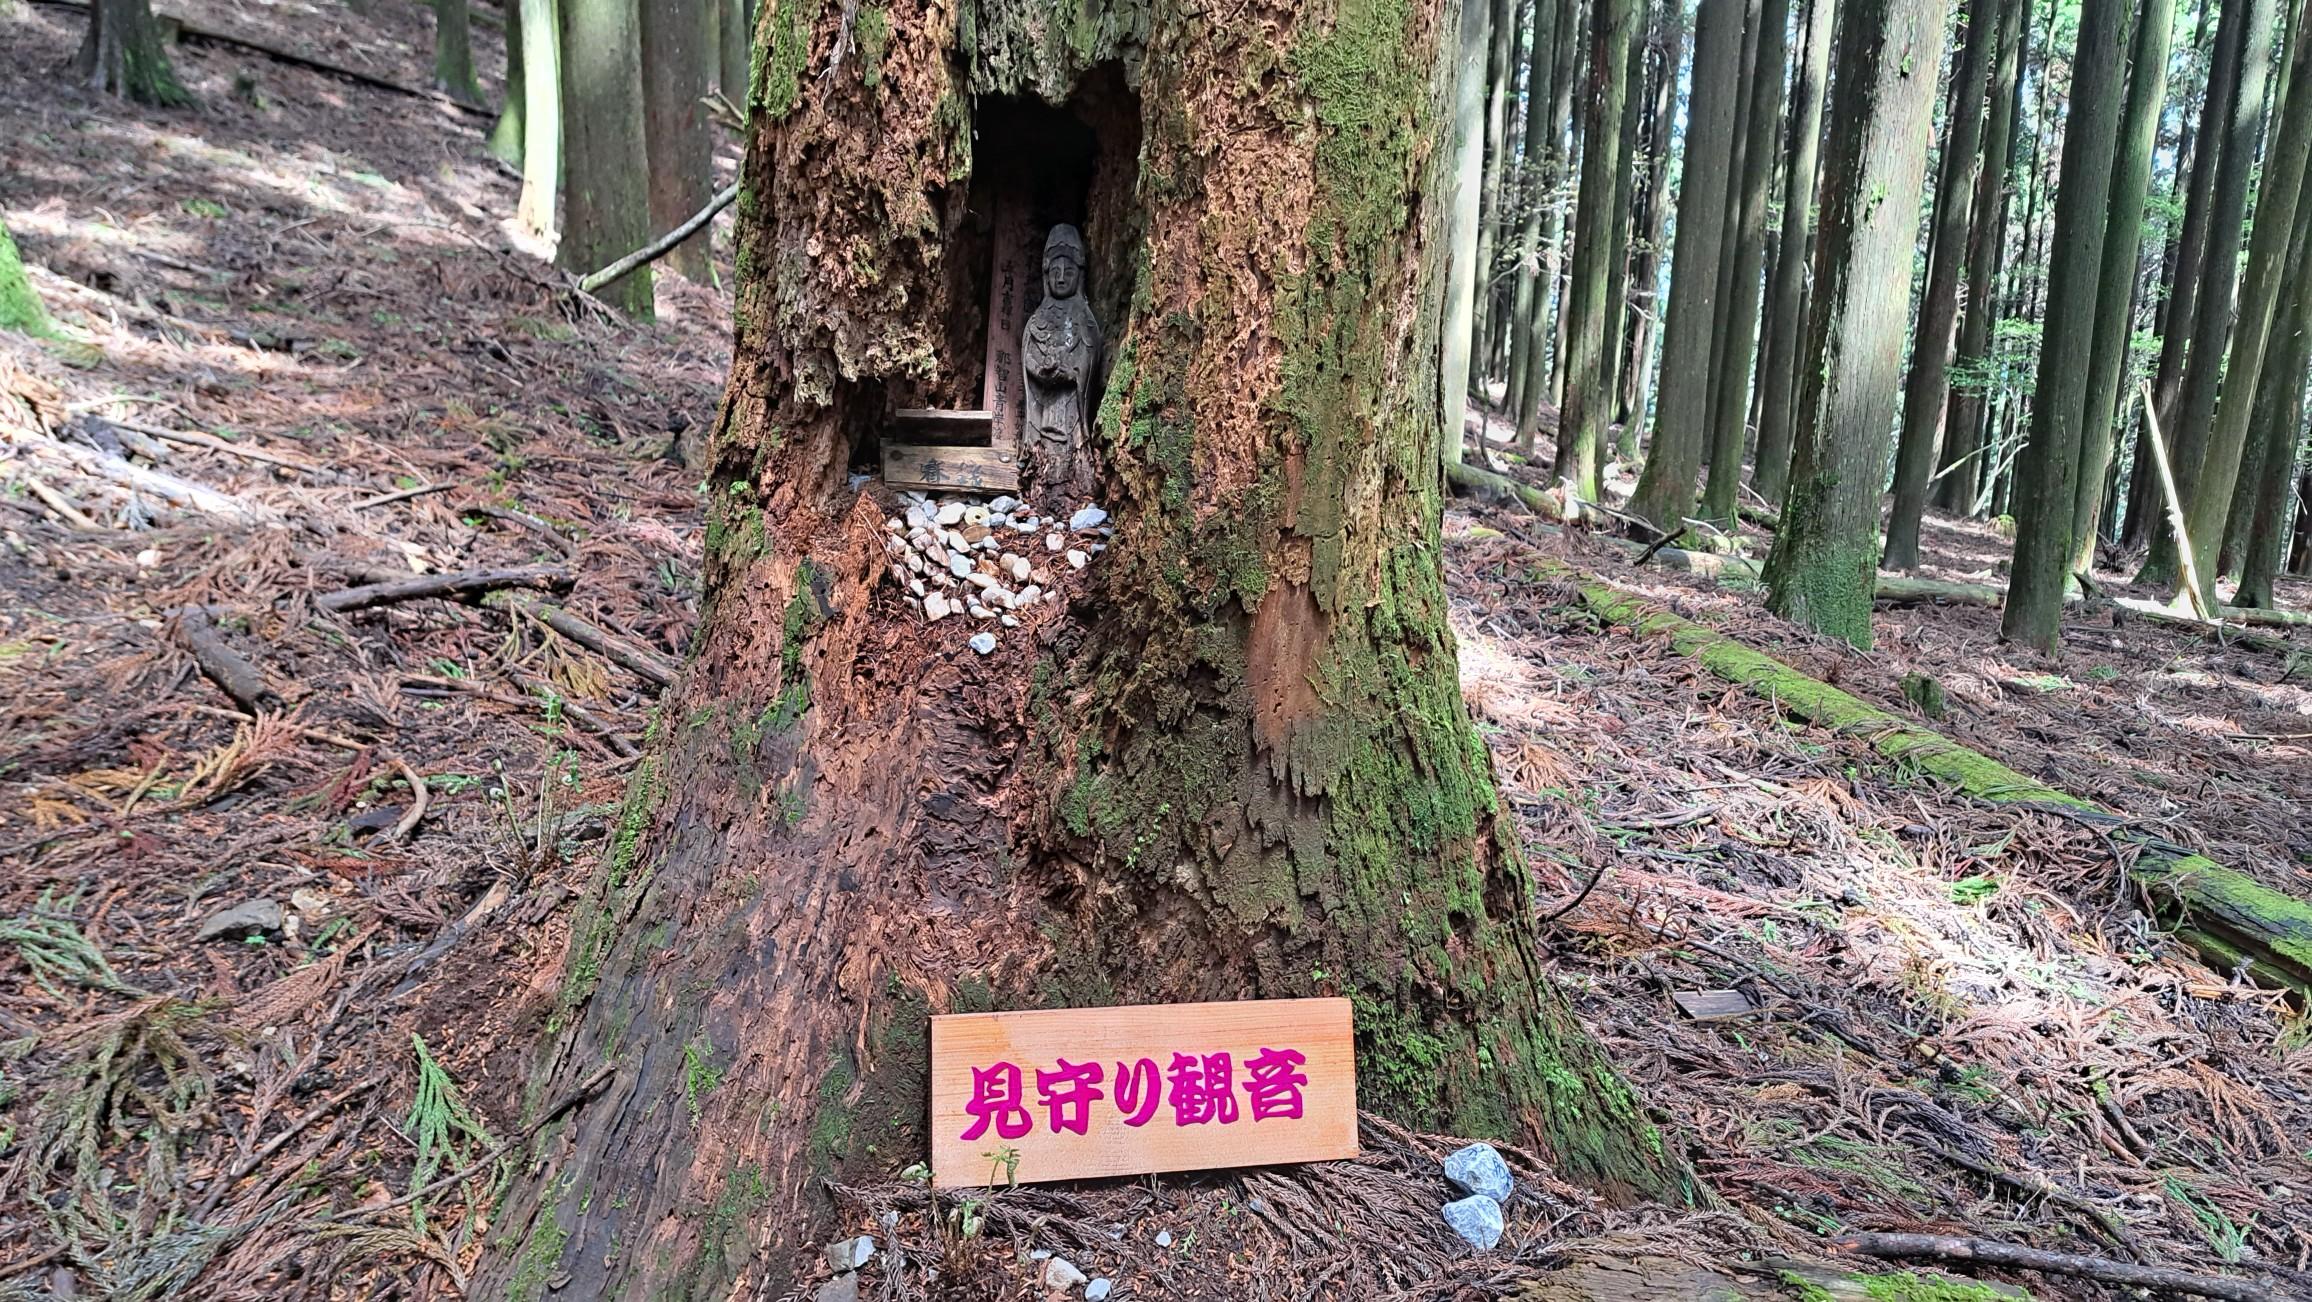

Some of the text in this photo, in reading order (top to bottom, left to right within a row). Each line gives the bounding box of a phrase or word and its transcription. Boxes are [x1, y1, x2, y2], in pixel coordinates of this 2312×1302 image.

[961, 1047, 1308, 1140] 見守り観音
